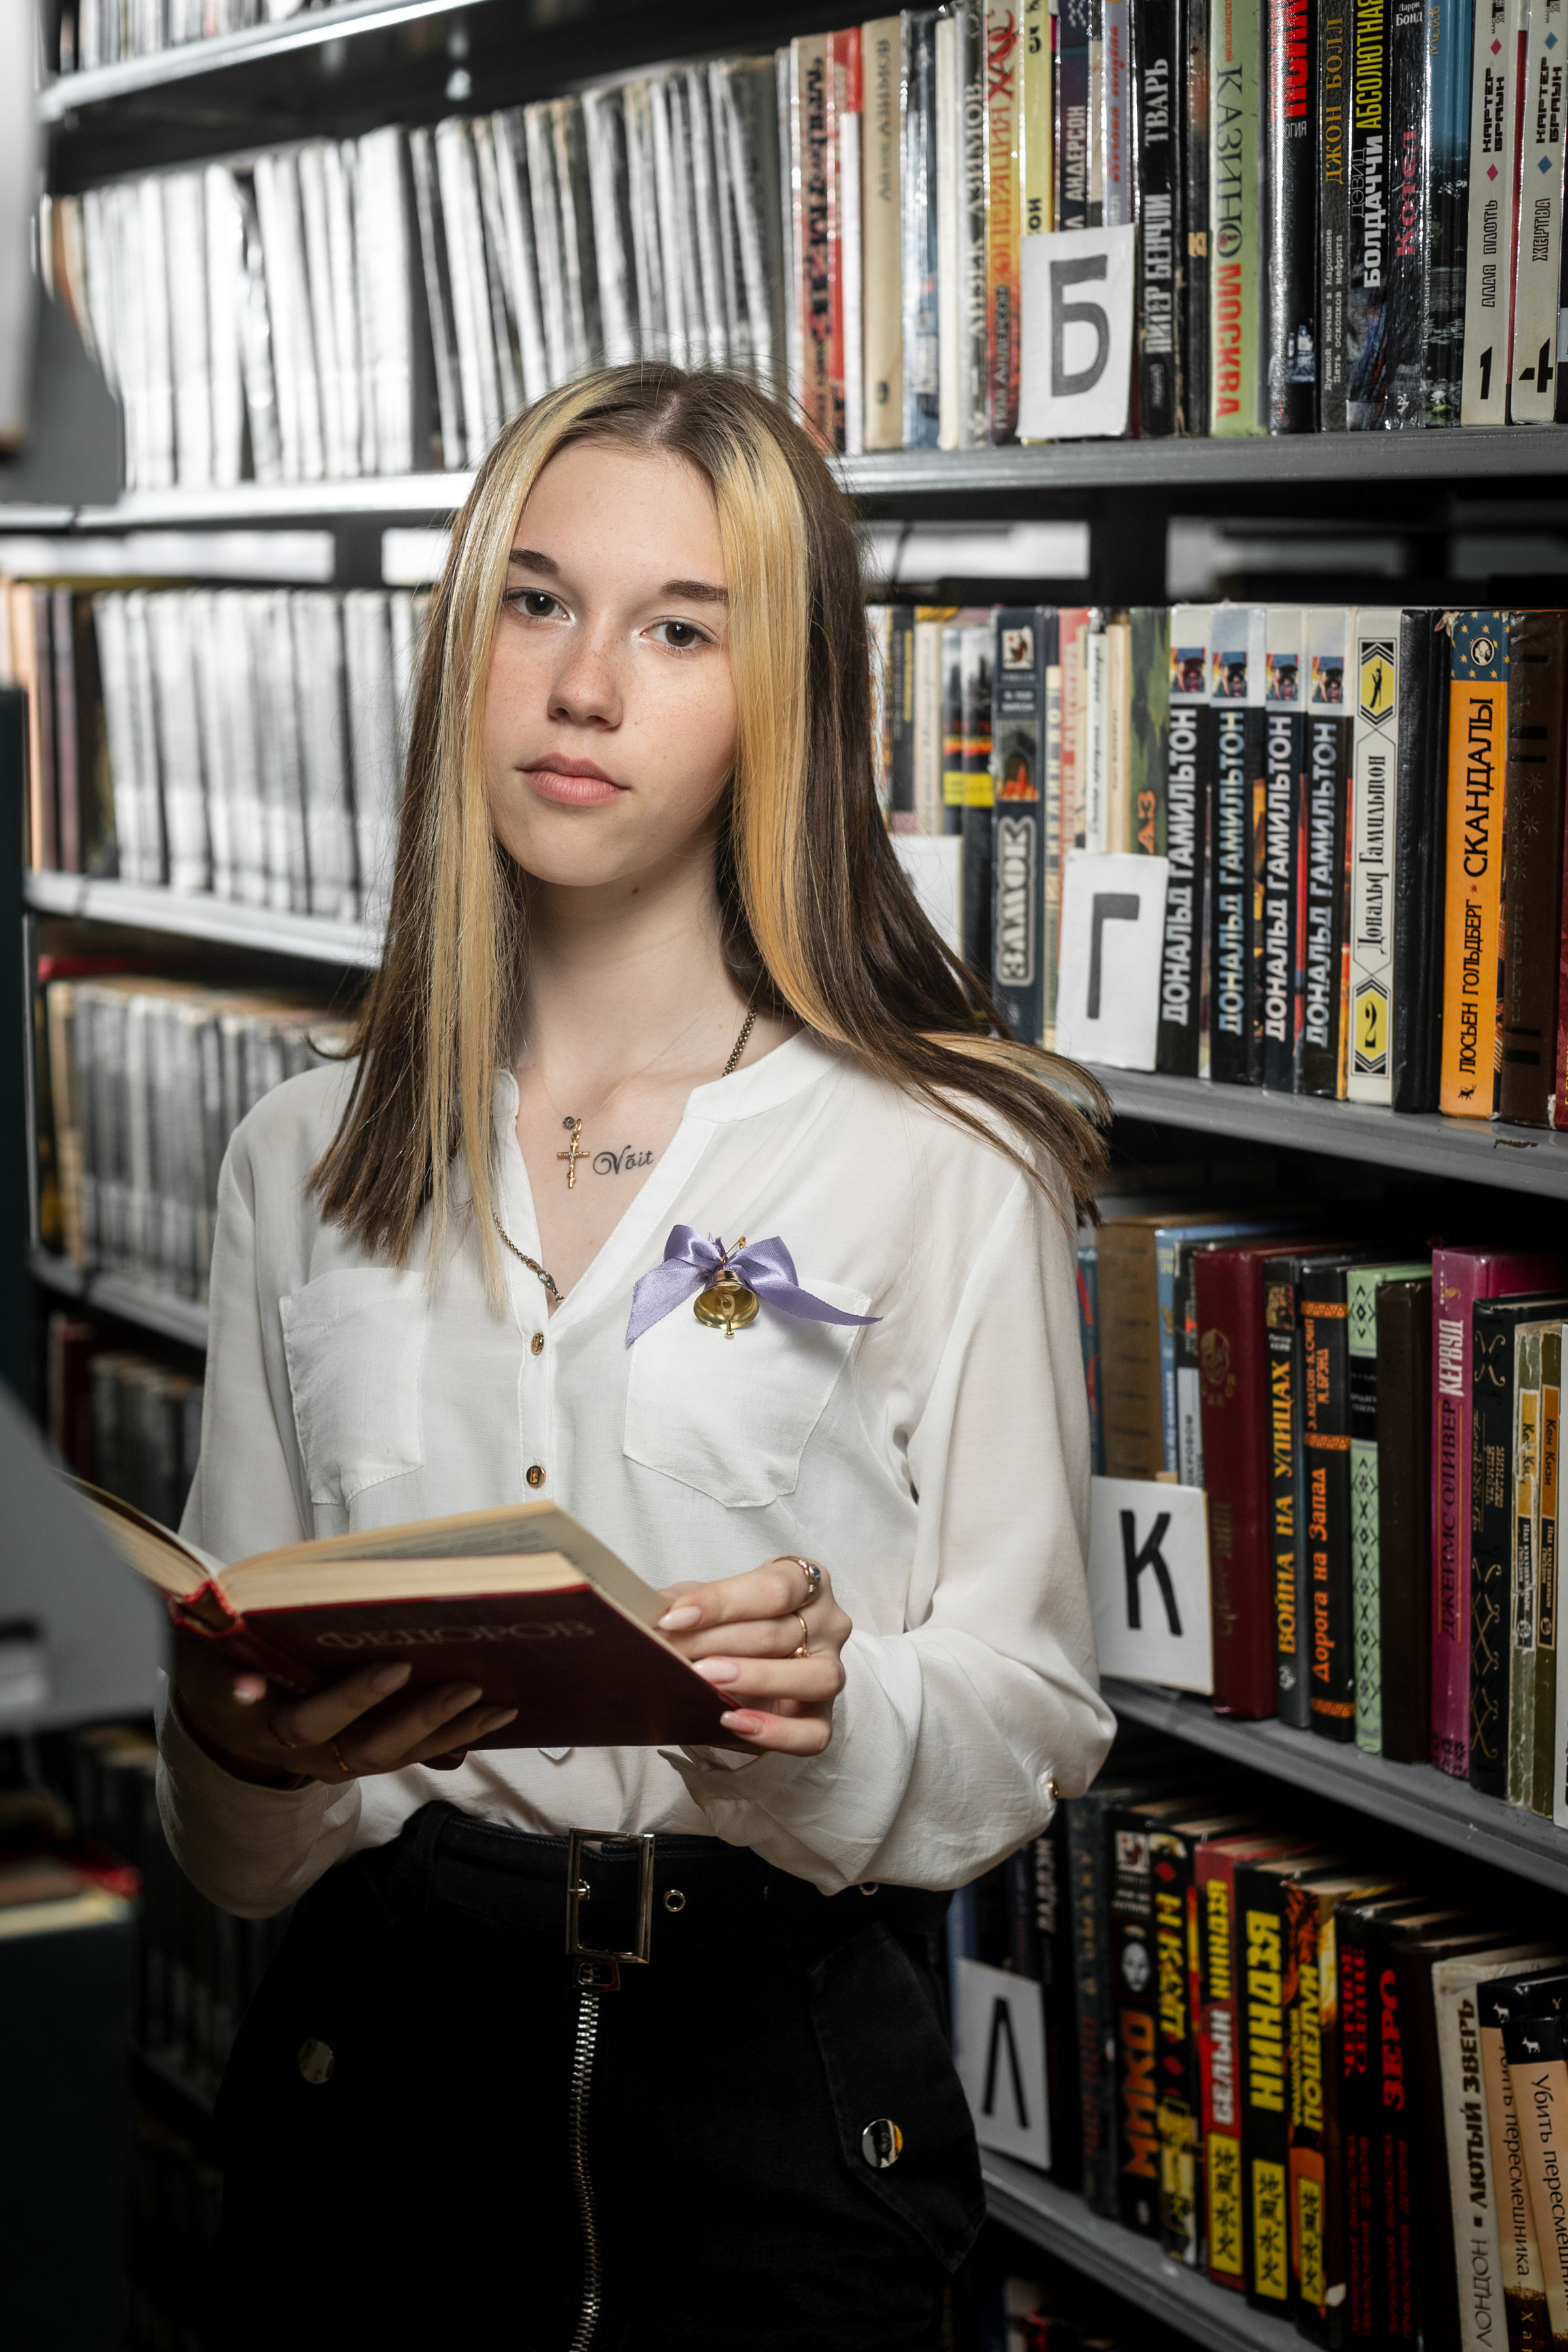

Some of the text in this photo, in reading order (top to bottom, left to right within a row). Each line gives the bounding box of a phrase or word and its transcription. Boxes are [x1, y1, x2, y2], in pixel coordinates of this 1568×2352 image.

[1224, 0, 1234, 61] езинский
[1065, 105, 1086, 201] АНДЕРСОН
[1144, 58, 1169, 148] ТВАРЬ
[1325, 16, 1345, 186] ДЖОН БОЛЛ
[1482, 67, 1494, 154] КАРТЕР
[1494, 76, 1506, 152] БРАУН
[1536, 56, 1549, 145] КАРТЕР
[1549, 65, 1563, 144] БРАУН
[987, 105, 1013, 280] ОПЕРАЦИЯ
[1144, 193, 1172, 280] БЕНЧЛИ
[1216, 64, 1243, 418] КАЗИНО МОСКВА
[1324, 229, 1333, 286] Каролине
[1352, 135, 1384, 289] ДЭВИД БОЛДАЧЧИ
[1481, 199, 1499, 308] АЛАЯ ПЛОТЬ
[1533, 197, 1552, 263] ЖЕРТВА
[1049, 253, 1111, 398] Б
[1144, 285, 1173, 355] ПИТЕР
[1323, 348, 1333, 391] Душной
[1324, 305, 1333, 342] ночью
[1333, 235, 1344, 384] Пять осколков нефрита
[1479, 346, 1494, 400] 1
[1518, 337, 1554, 394] 4
[1001, 818, 1031, 981] ЗАМОК
[1162, 708, 1198, 1026] ДОНАЛЬД ГАМИЛЬТОН
[1218, 711, 1245, 1036] ДОНАЛЬД ГАМИЛЬТОН
[1264, 714, 1293, 1042] ДОНАЛЬД ГАМИЛЬТОН
[1305, 721, 1337, 1047] ДОНАЛЬД ГАМИЛЬТОН
[1357, 755, 1389, 955] Дональд Гамильтон
[1459, 698, 1495, 1075] ЛЮСЬЕН ГОЛЬДБЕРГ СКАНДАЛЫ
[1086, 892, 1141, 1021] Г
[1364, 1001, 1378, 1049] 2
[1438, 1318, 1465, 1397] КЕРВУД
[1271, 1359, 1298, 1655] ВОЙНА НА УЛИЦАХ
[1439, 1399, 1458, 1641] ДЖЕЙМС ОЛИВЕР
[1544, 1418, 1556, 1486] Кен Кизи
[1119, 1510, 1183, 1637] К
[1309, 1467, 1334, 1684] Дорога на Запад
[1206, 1878, 1231, 2000] НИНДЗЯ
[981, 1996, 1030, 2131] Л
[1245, 1909, 1286, 2113] НИНДЗЯ
[1379, 1968, 1405, 2112] ЗЕРО
[1457, 1997, 1493, 2349] ЛОНДОН ЛЮТЫЙ ЗВЕРЬ
[1531, 2074, 1555, 2144] Убить
[1346, 2133, 1362, 2337] ЗАРУБЕЖНАЯ ФАНТАСТИКА
[1358, 2136, 1373, 2337] ПРИКЛЮЧЕНИЯ ДЕТЕКТИВ
[1382, 2133, 1399, 2337] ЗАРУБЕЖНАЯ ФАНТАСТИКА
[1397, 2139, 1413, 2340] ПРИКЛЮЧЕНИЯ ДЕТЕКТИВ
[1502, 2114, 1530, 2276] пересмешника
